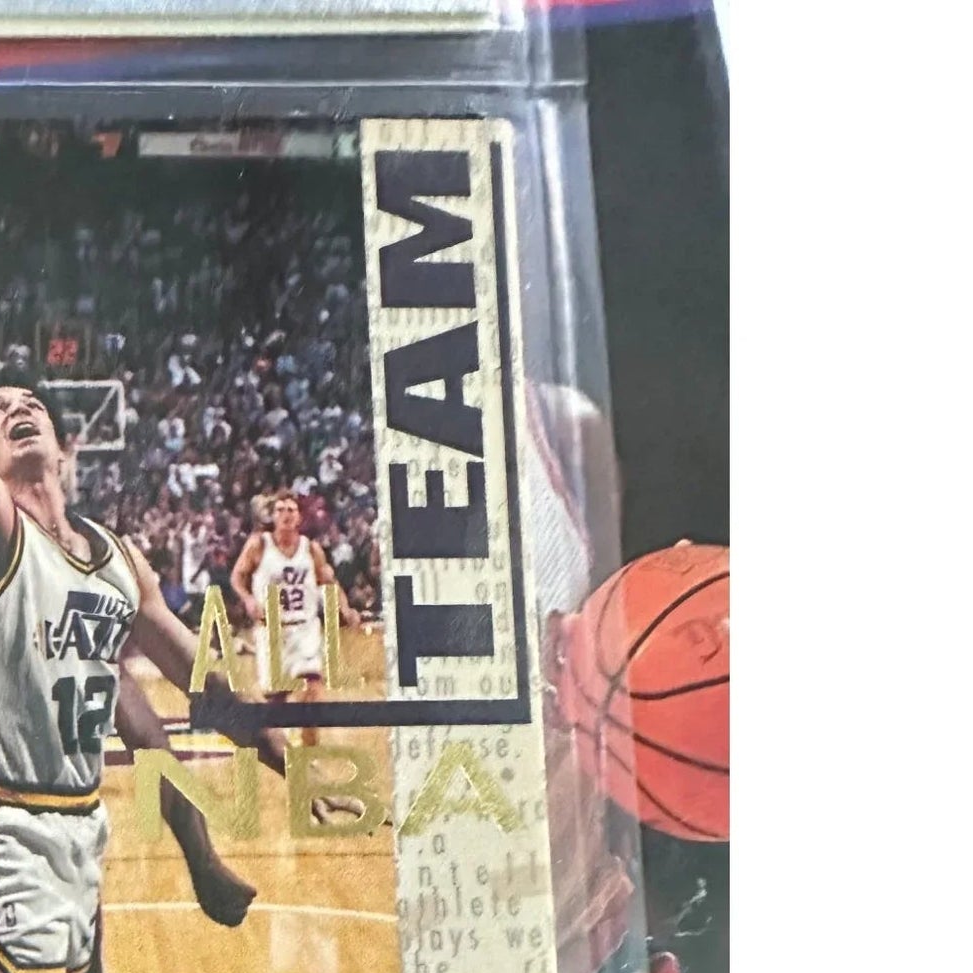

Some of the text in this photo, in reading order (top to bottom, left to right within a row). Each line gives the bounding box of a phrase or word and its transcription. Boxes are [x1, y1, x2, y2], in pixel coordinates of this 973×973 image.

[374, 150, 495, 687] TEAM
[188, 584, 369, 693] ALL
[51, 675, 117, 754] 12
[132, 741, 526, 841] NBA
